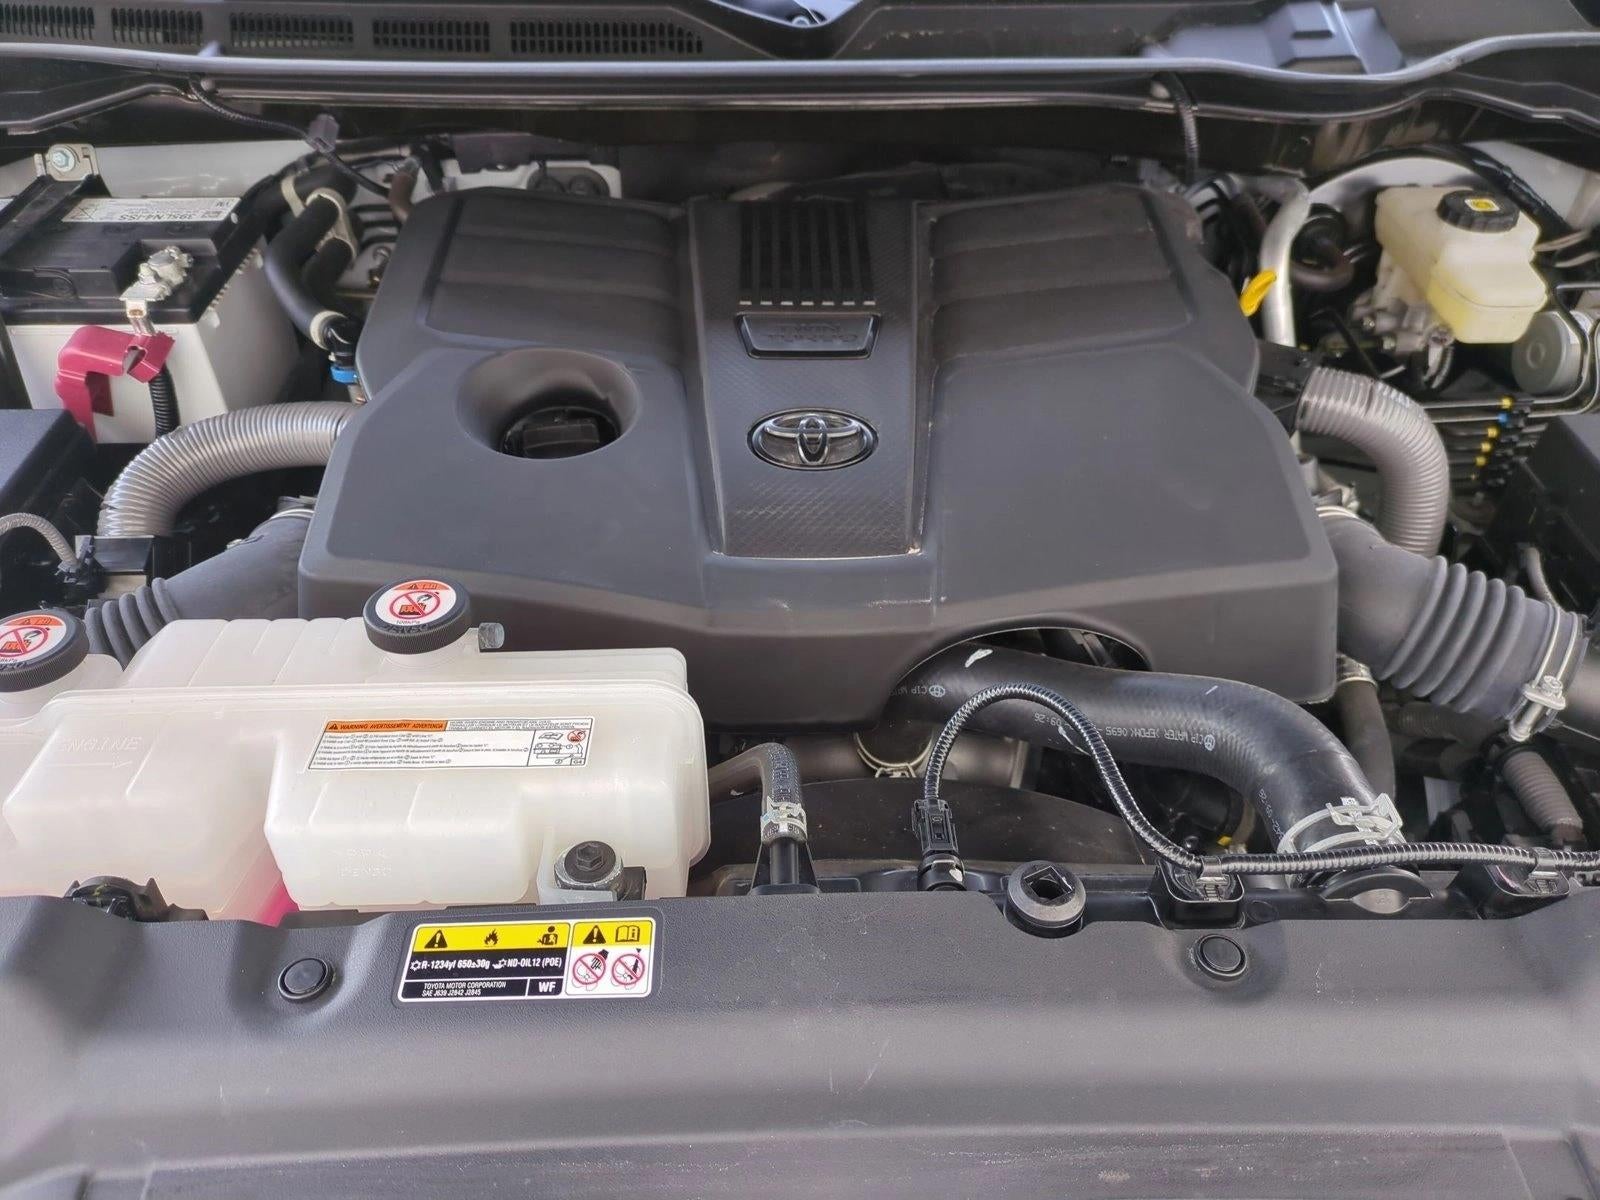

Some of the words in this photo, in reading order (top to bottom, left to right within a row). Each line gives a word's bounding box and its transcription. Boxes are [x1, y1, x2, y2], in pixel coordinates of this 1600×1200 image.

[421, 959, 457, 971] R-1234yf
[541, 957, 562, 969] (POE)
[424, 982, 445, 990] TOYOTA
[467, 981, 507, 989] CORPORATION
[538, 981, 557, 993] WF
[421, 989, 433, 997] SAE
